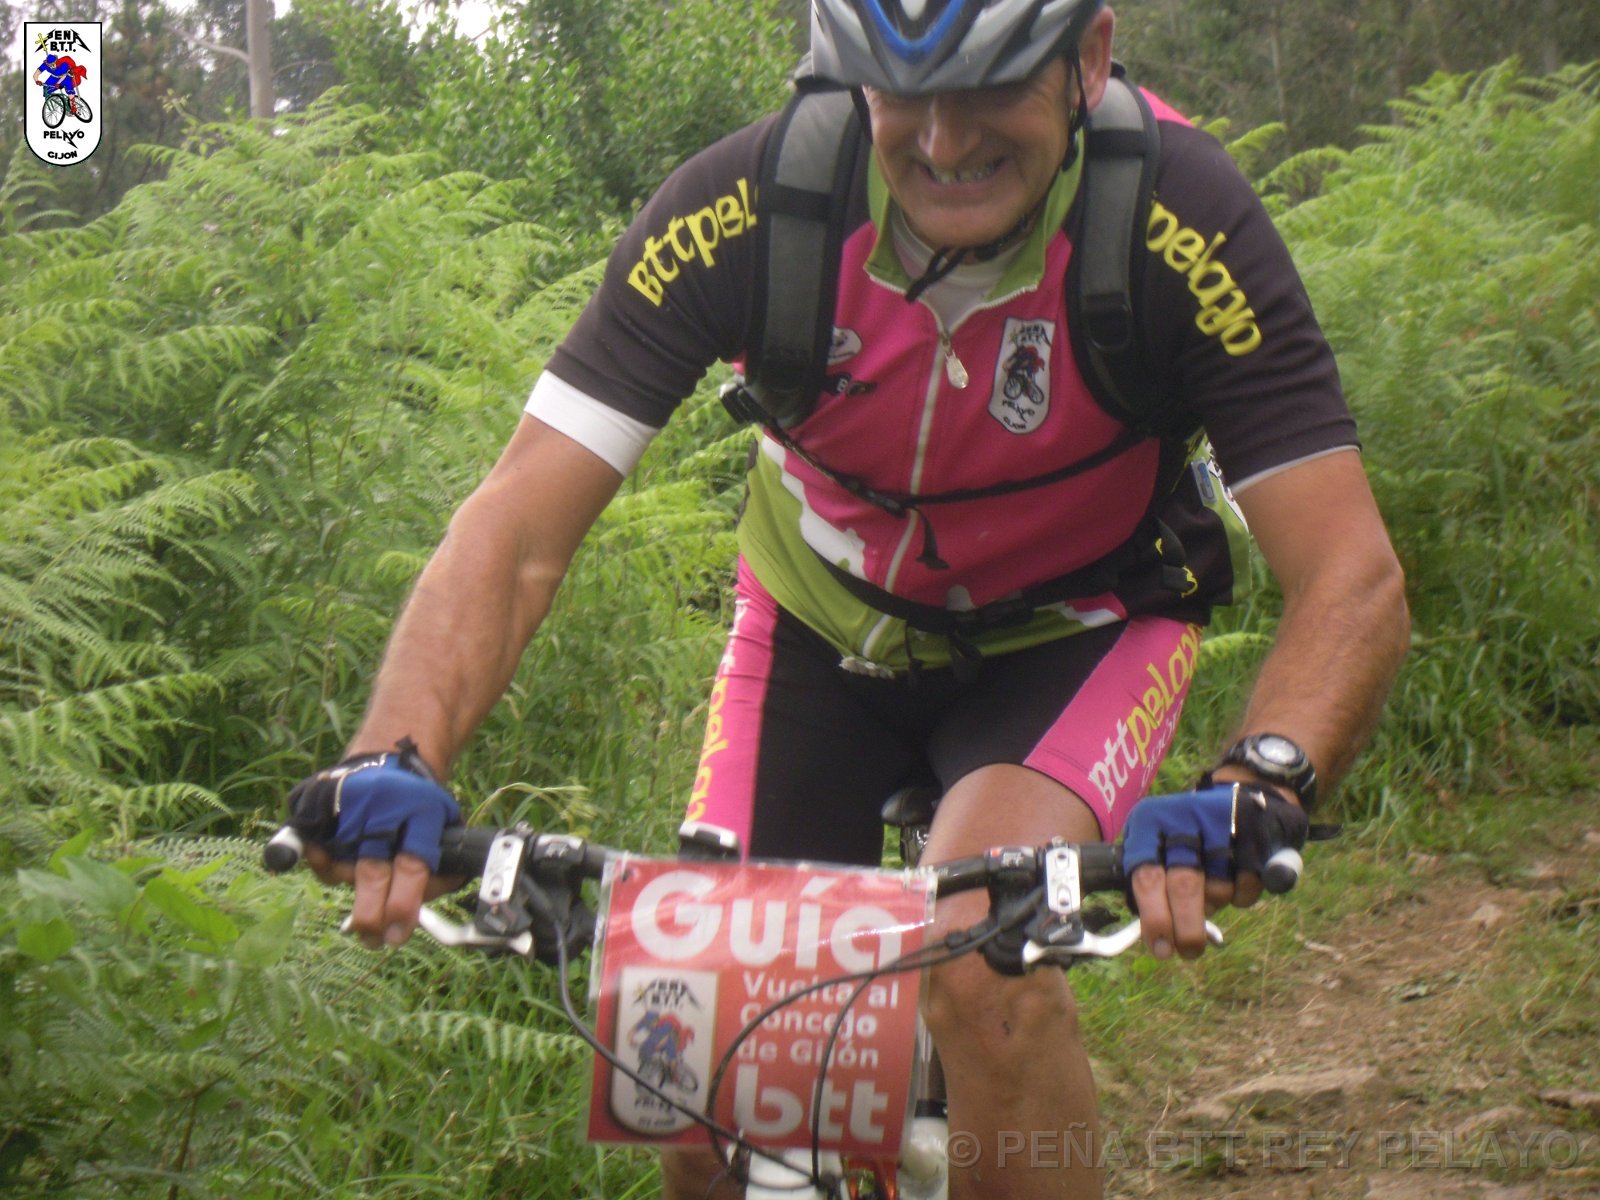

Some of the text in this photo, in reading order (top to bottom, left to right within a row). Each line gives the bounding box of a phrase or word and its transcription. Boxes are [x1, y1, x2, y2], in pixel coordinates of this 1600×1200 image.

[627, 177, 759, 307] Bttpel
[1088, 622, 1203, 814] Bttpelay
[631, 869, 902, 975] Guía
[740, 1003, 878, 1040] Concejo
[743, 971, 899, 1009] Vuelta al
[736, 1036, 778, 1064] de
[733, 1064, 888, 1144] btt
